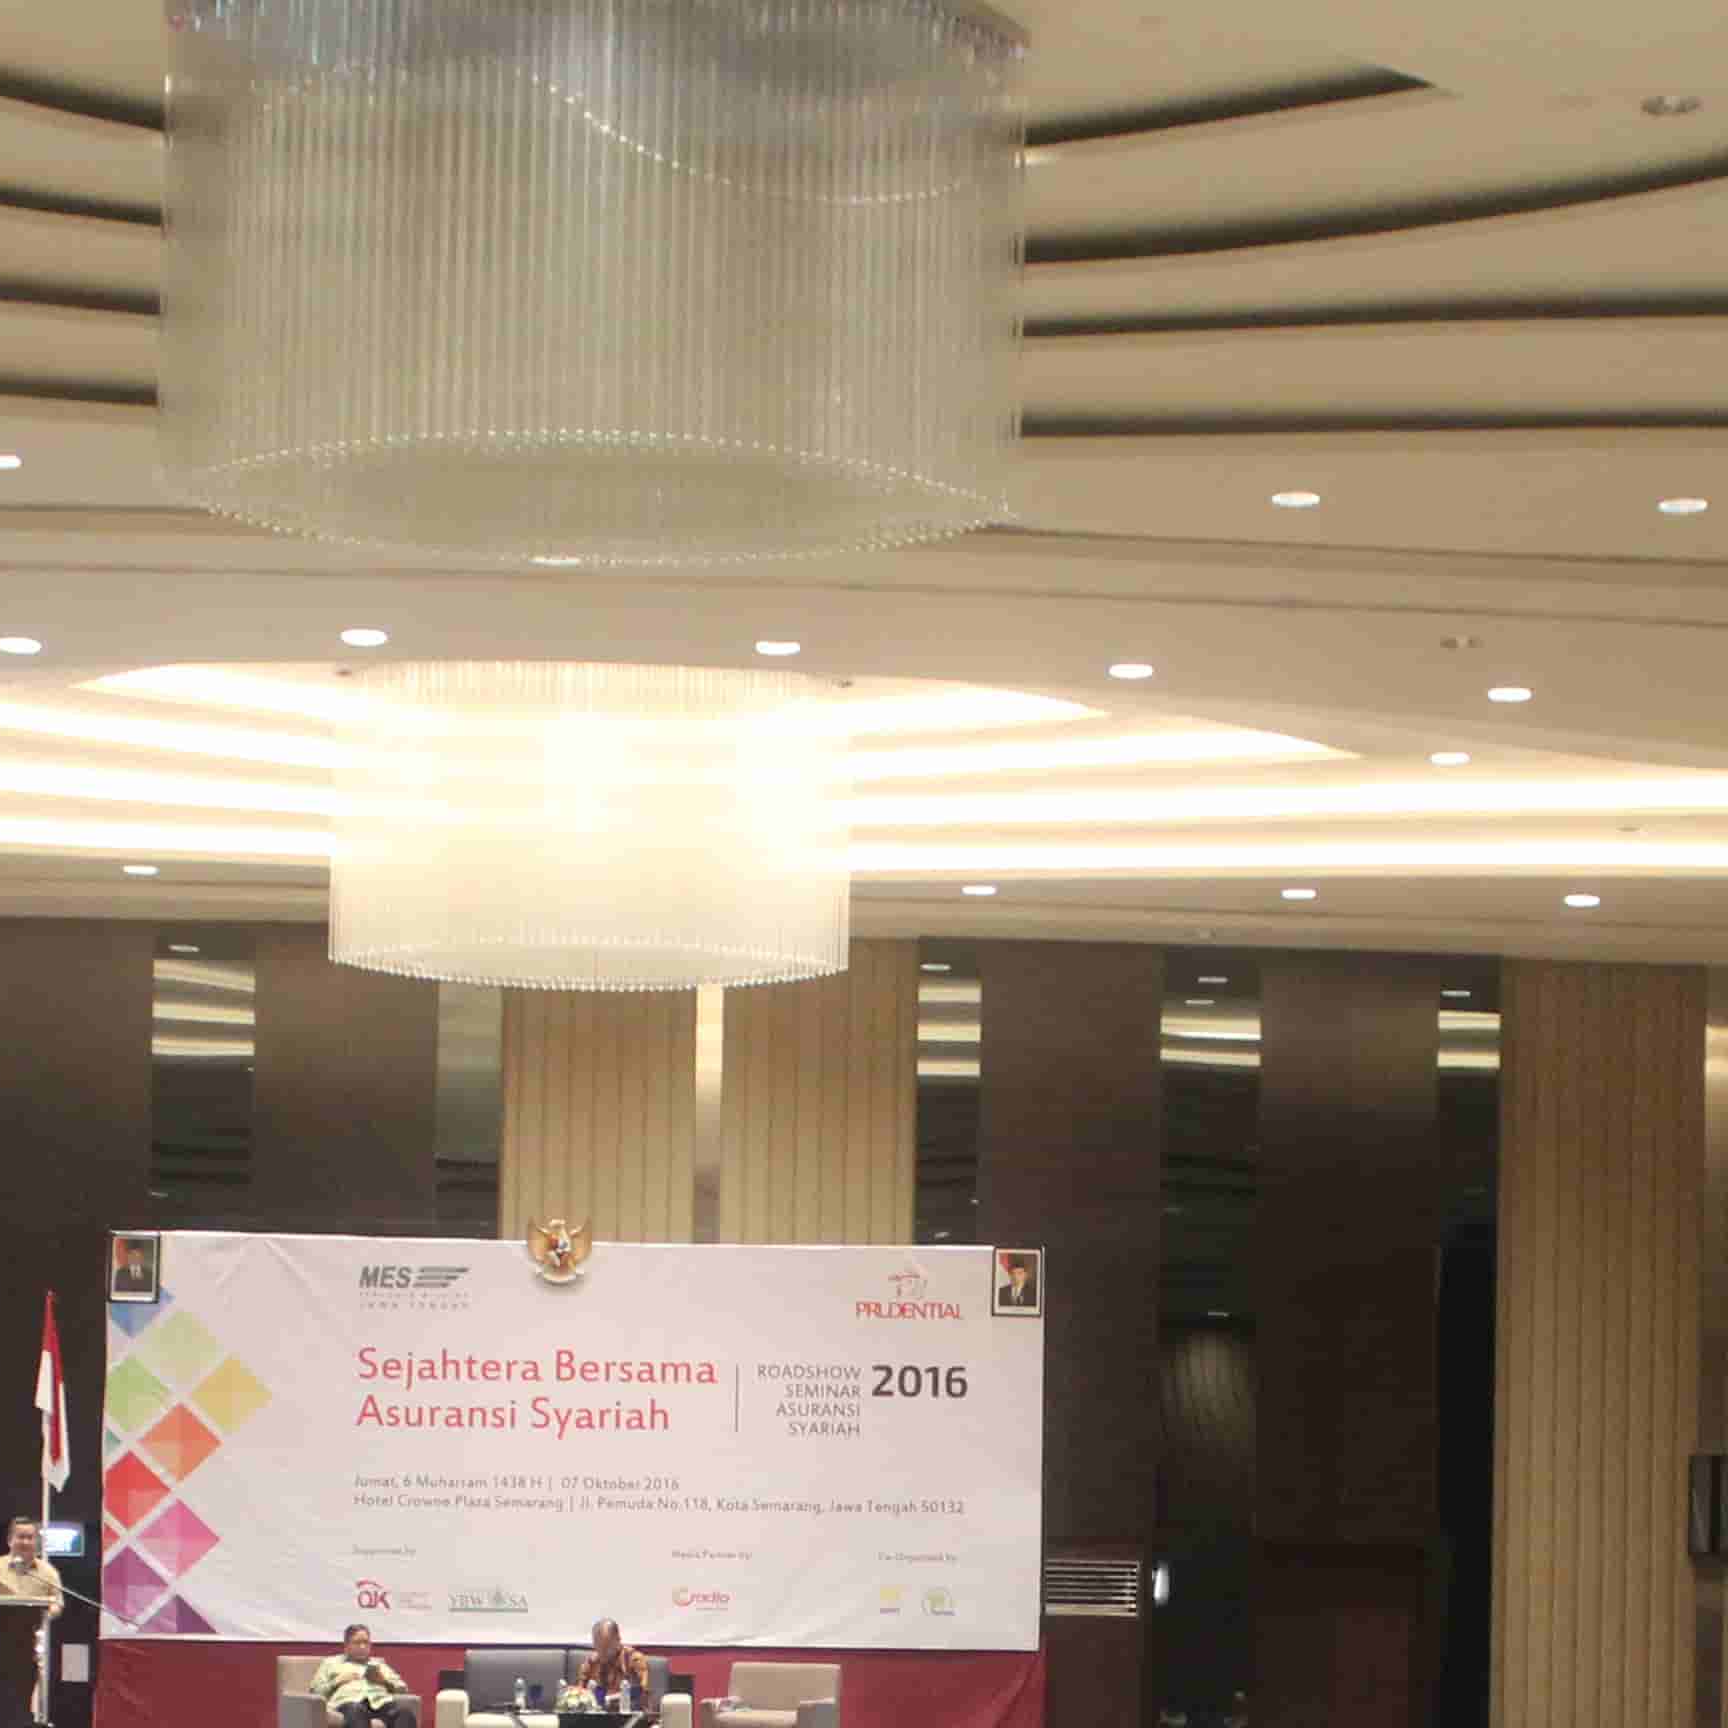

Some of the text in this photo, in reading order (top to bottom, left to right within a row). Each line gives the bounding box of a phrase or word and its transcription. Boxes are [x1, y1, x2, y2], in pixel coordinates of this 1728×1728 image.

[359, 1265, 411, 1289] MES
[855, 1300, 964, 1320] PRUDENTIAL
[357, 1346, 718, 1391] Sejahtera Bersama
[756, 1363, 862, 1380] ROADSHOW
[871, 1364, 969, 1399] 2016
[784, 1383, 862, 1399] SEMINAR
[355, 1393, 670, 1440] Asuransi Syariah
[775, 1402, 861, 1418] ASURANSI
[788, 1421, 861, 1437] SYARIAH
[561, 1476, 579, 1490] 07
[584, 1476, 640, 1490] Oktober
[644, 1476, 680, 1490] 2016
[717, 1499, 749, 1511] Kota
[831, 1500, 863, 1513] Jawa
[867, 1500, 917, 1517] Tengah
